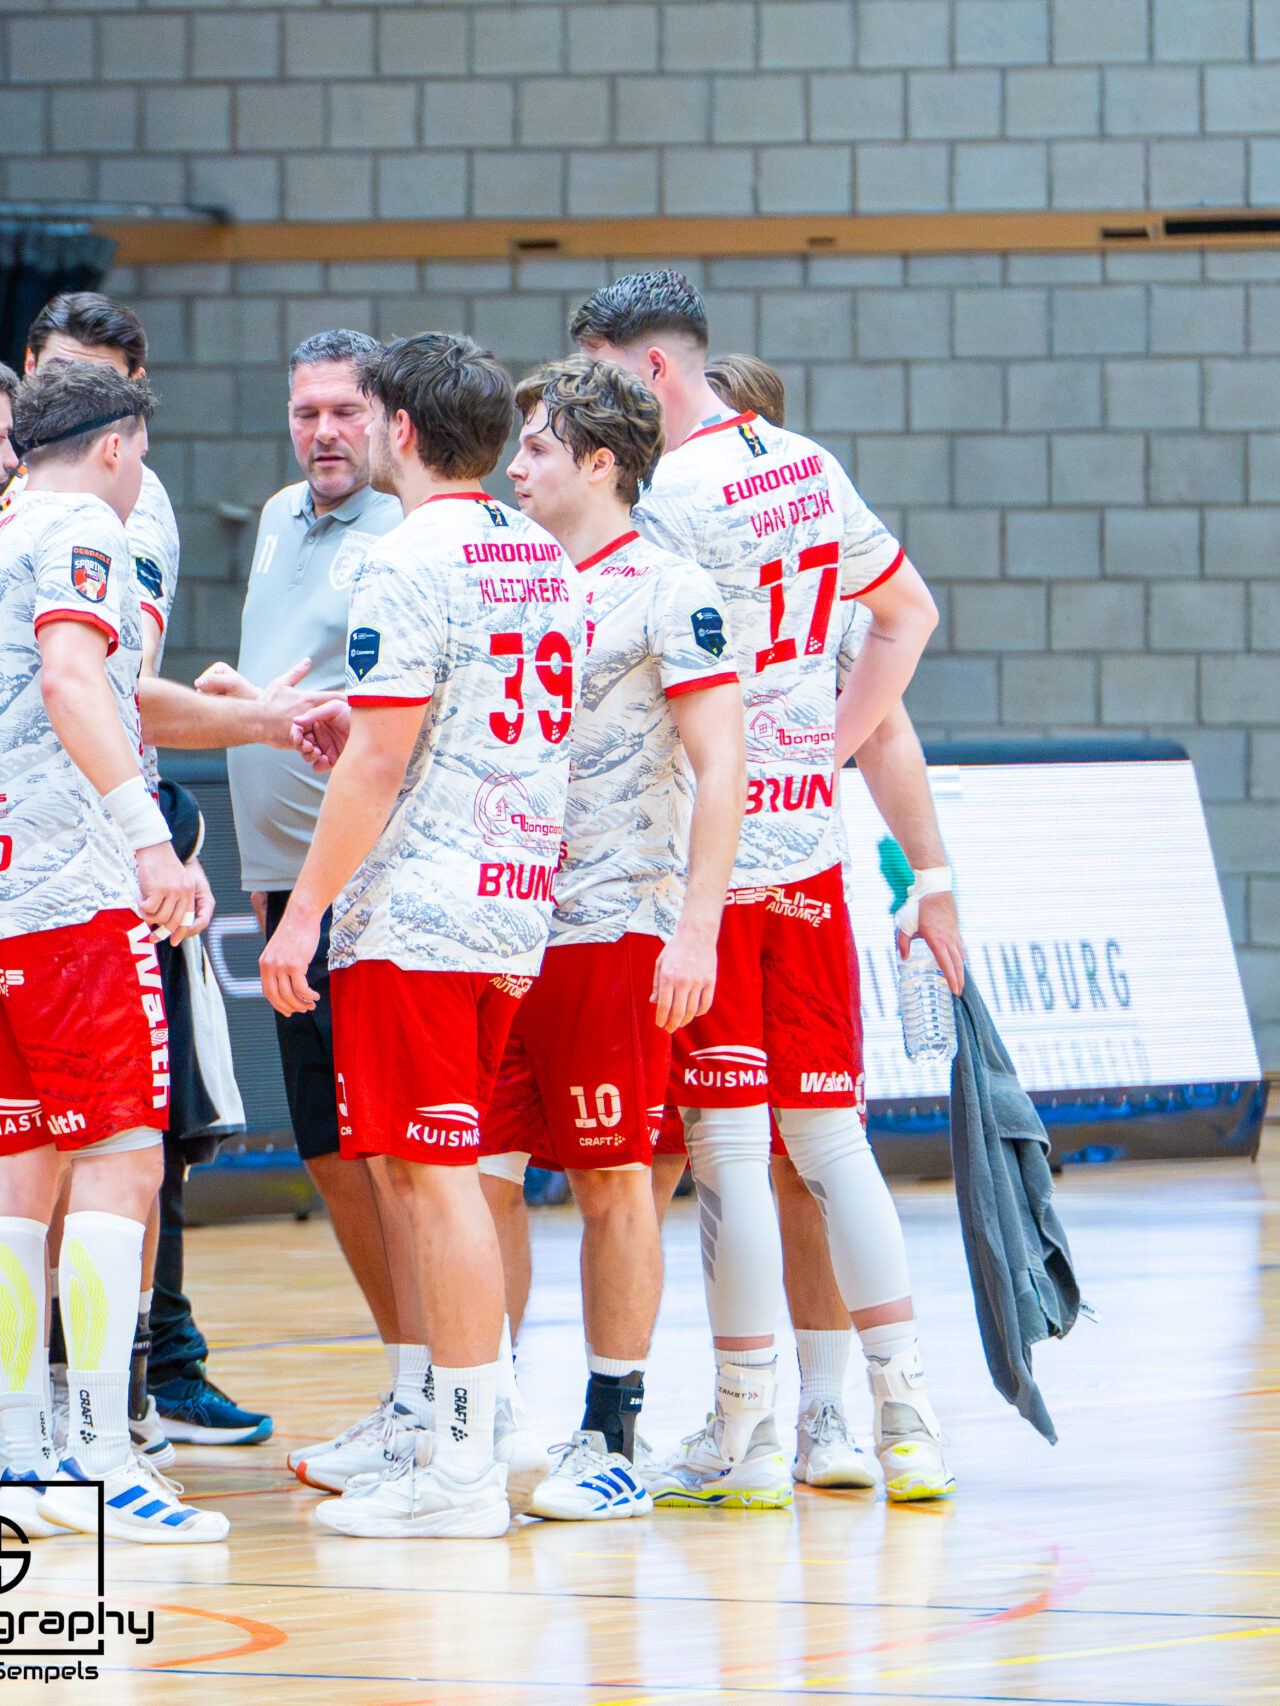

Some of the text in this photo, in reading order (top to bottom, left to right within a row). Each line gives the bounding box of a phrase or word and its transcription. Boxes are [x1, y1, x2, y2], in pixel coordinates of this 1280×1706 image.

[750, 508, 786, 539] VAN
[462, 543, 562, 565] EUROQUIP
[755, 541, 840, 674] 17
[489, 631, 574, 745] 39
[980, 937, 1133, 1016] IMBURG
[801, 1070, 854, 1093] Walth
[569, 1083, 623, 1129] 10
[579, 1136, 613, 1147] CRAFT
[79, 1389, 94, 1429] CRAFT
[454, 1387, 468, 1425] CRAFT
